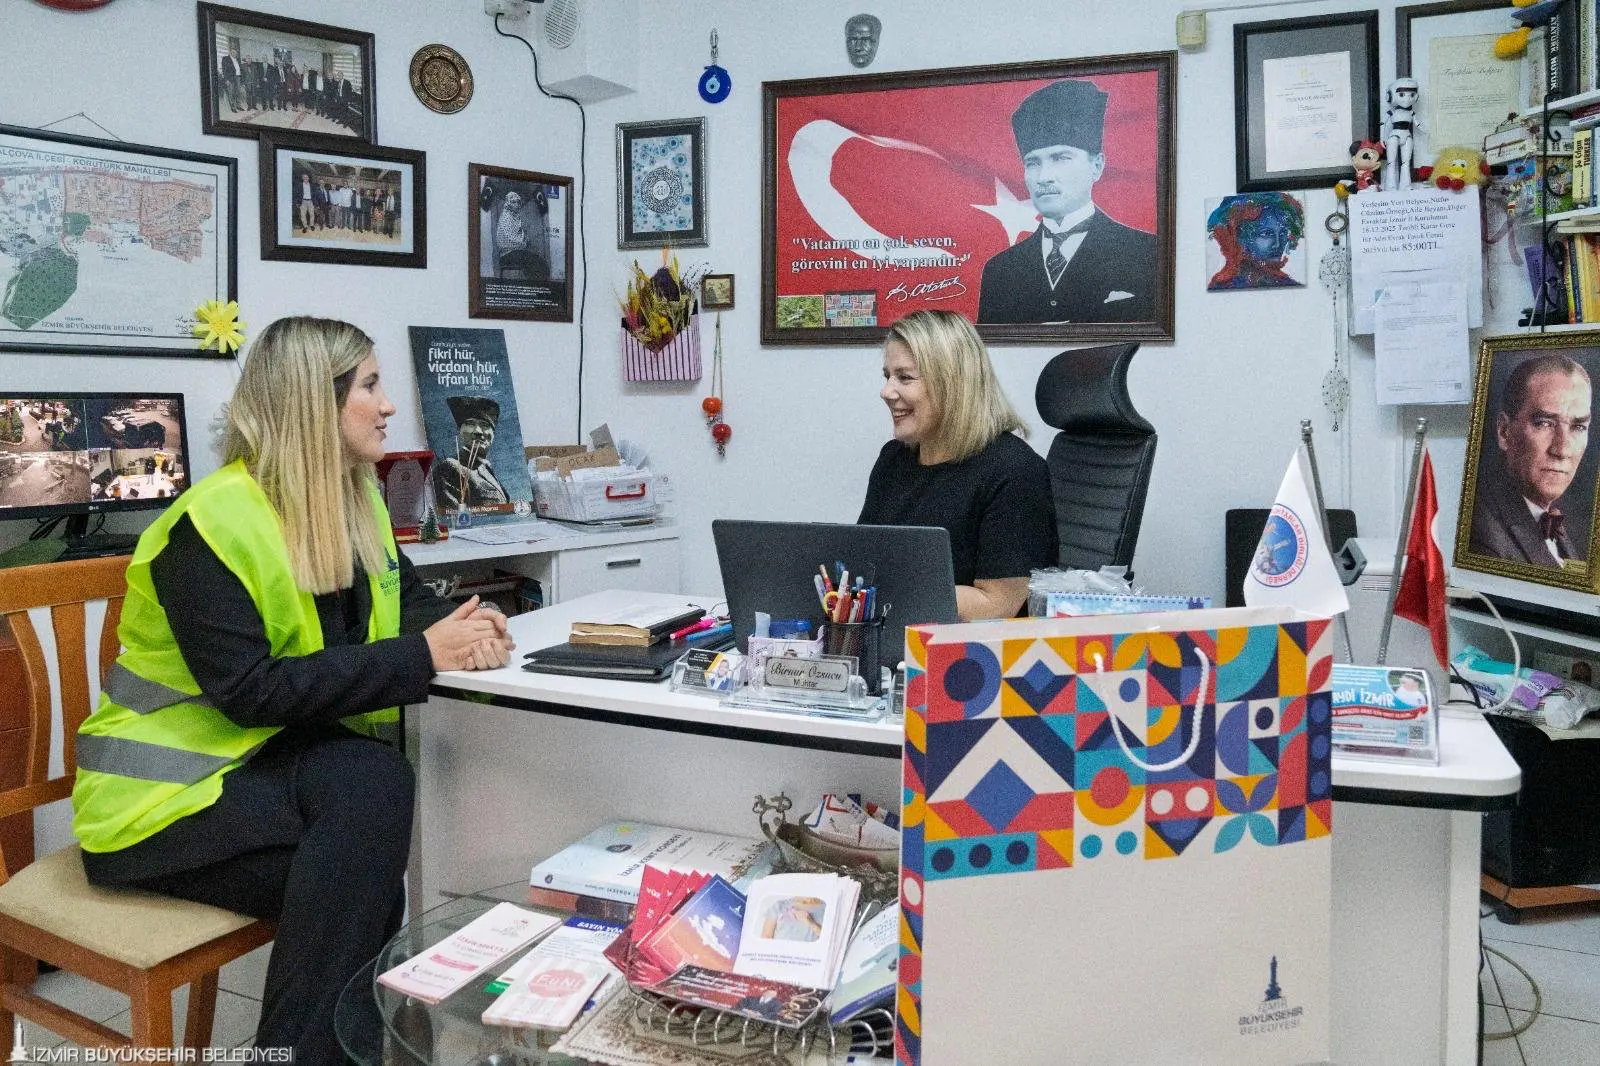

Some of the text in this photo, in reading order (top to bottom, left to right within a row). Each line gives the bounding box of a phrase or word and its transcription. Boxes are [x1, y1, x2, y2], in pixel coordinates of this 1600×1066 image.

[1550, 57, 1558, 90] NUTUK
[36, 152, 65, 163] İLÇESİ
[124, 164, 171, 177] MAHALLESİ
[863, 238, 880, 249] en
[883, 236, 911, 251] çok
[913, 235, 957, 248] seven,
[791, 257, 847, 273] görevini
[851, 260, 868, 269] en
[872, 255, 890, 271] iyi
[428, 348, 475, 361] fikri hür,
[428, 360, 499, 375] vicdanı hür,
[437, 373, 493, 387] irfanı hür,
[770, 662, 804, 676] Birnur
[793, 678, 818, 688] Muhtar
[1360, 688, 1395, 707] İZMİR
[576, 921, 604, 931] SAYIN
[1239, 1006, 1303, 1026] BÜYÜKŞEHİR
